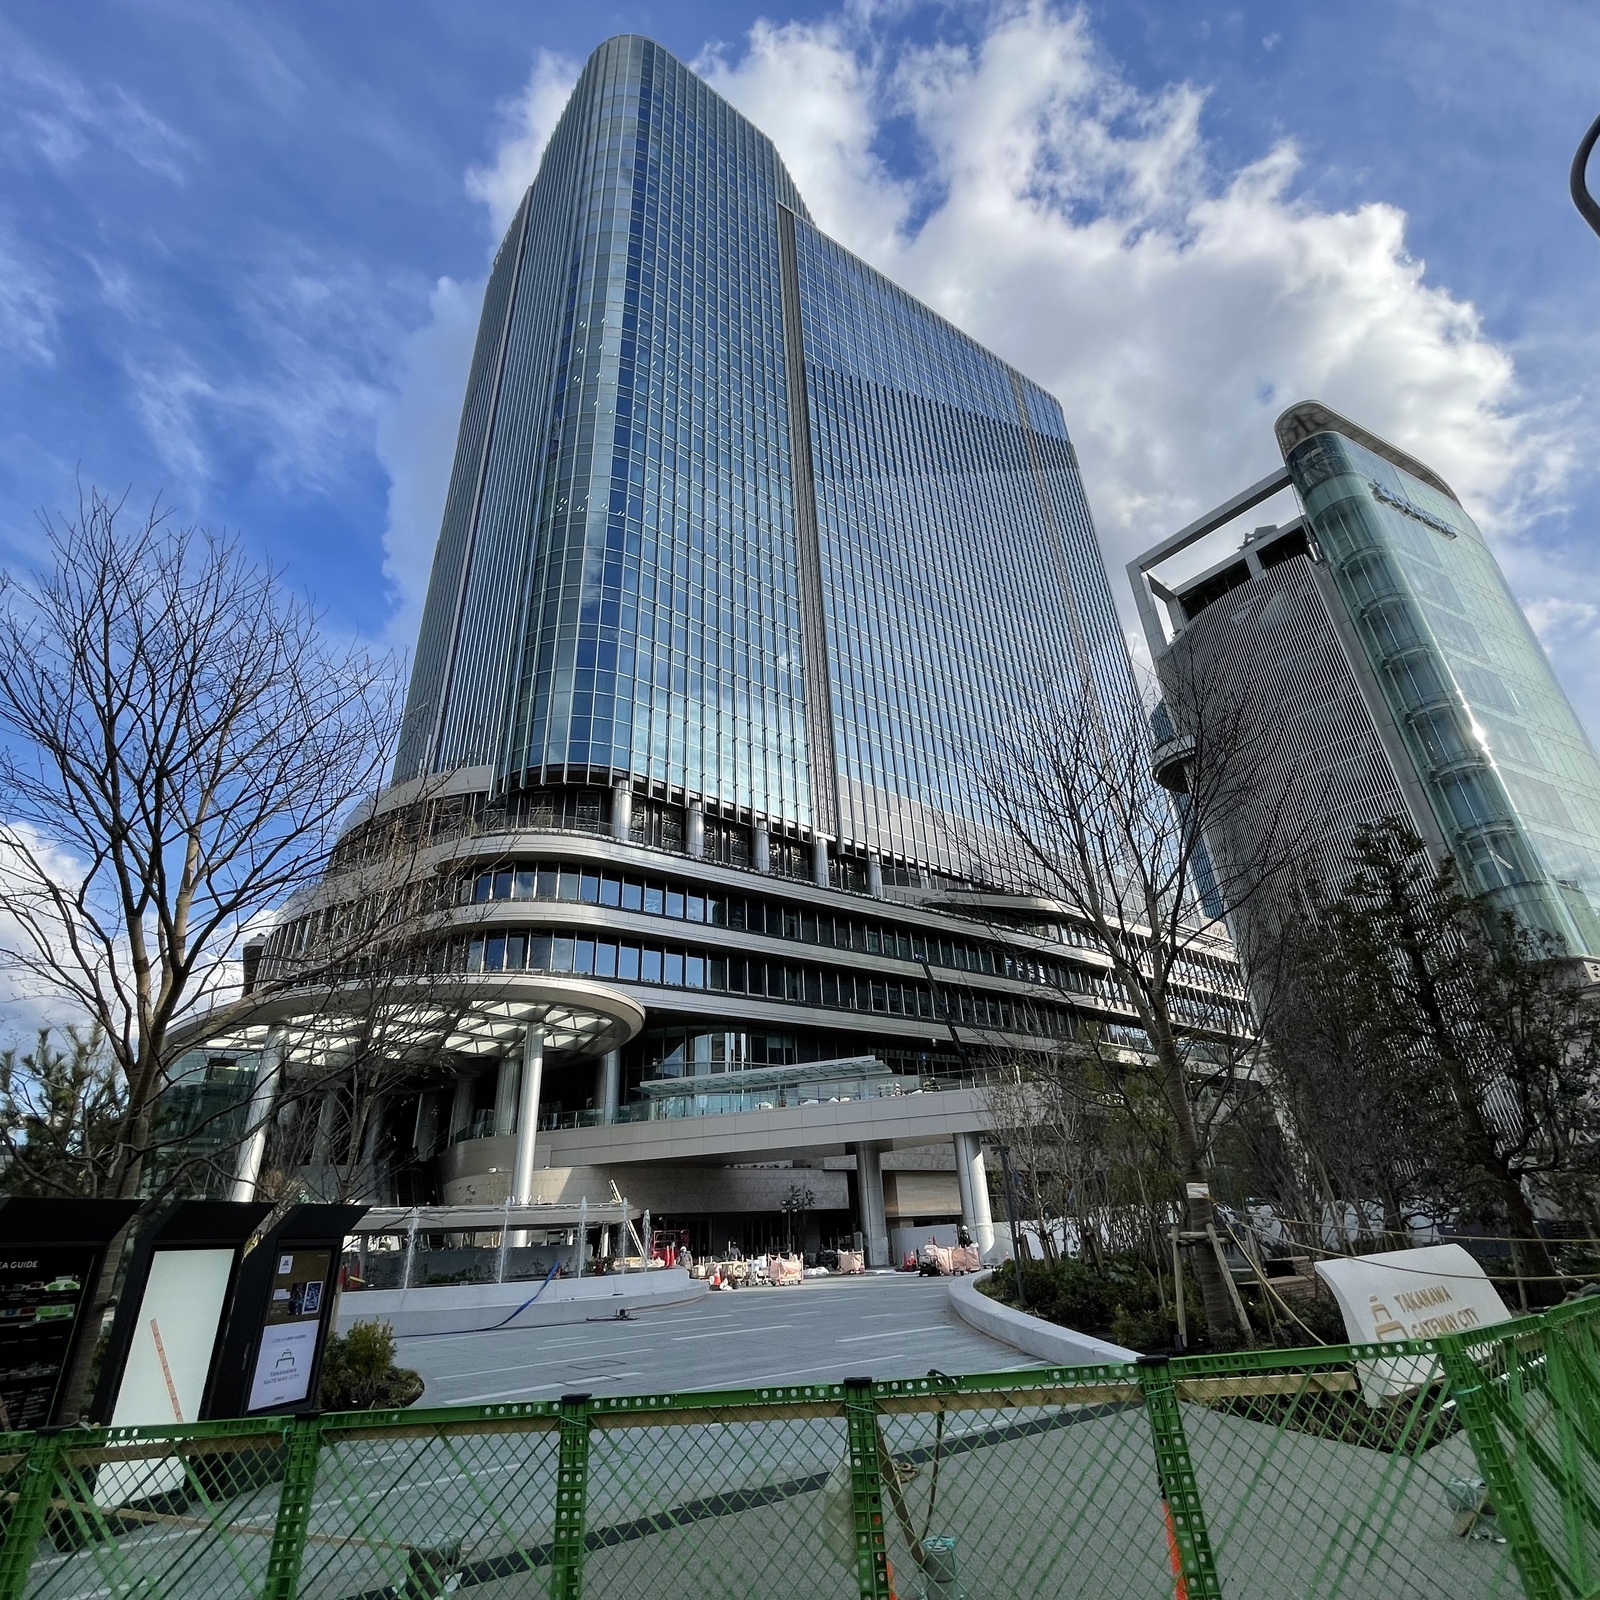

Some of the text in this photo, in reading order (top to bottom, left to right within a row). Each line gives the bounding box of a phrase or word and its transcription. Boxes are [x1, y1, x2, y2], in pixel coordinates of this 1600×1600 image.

[10, 1260, 39, 1269] GUIDE
[1393, 1285, 1453, 1313] TAKANAWA
[1411, 1306, 1480, 1339] GATEWAY CITY
